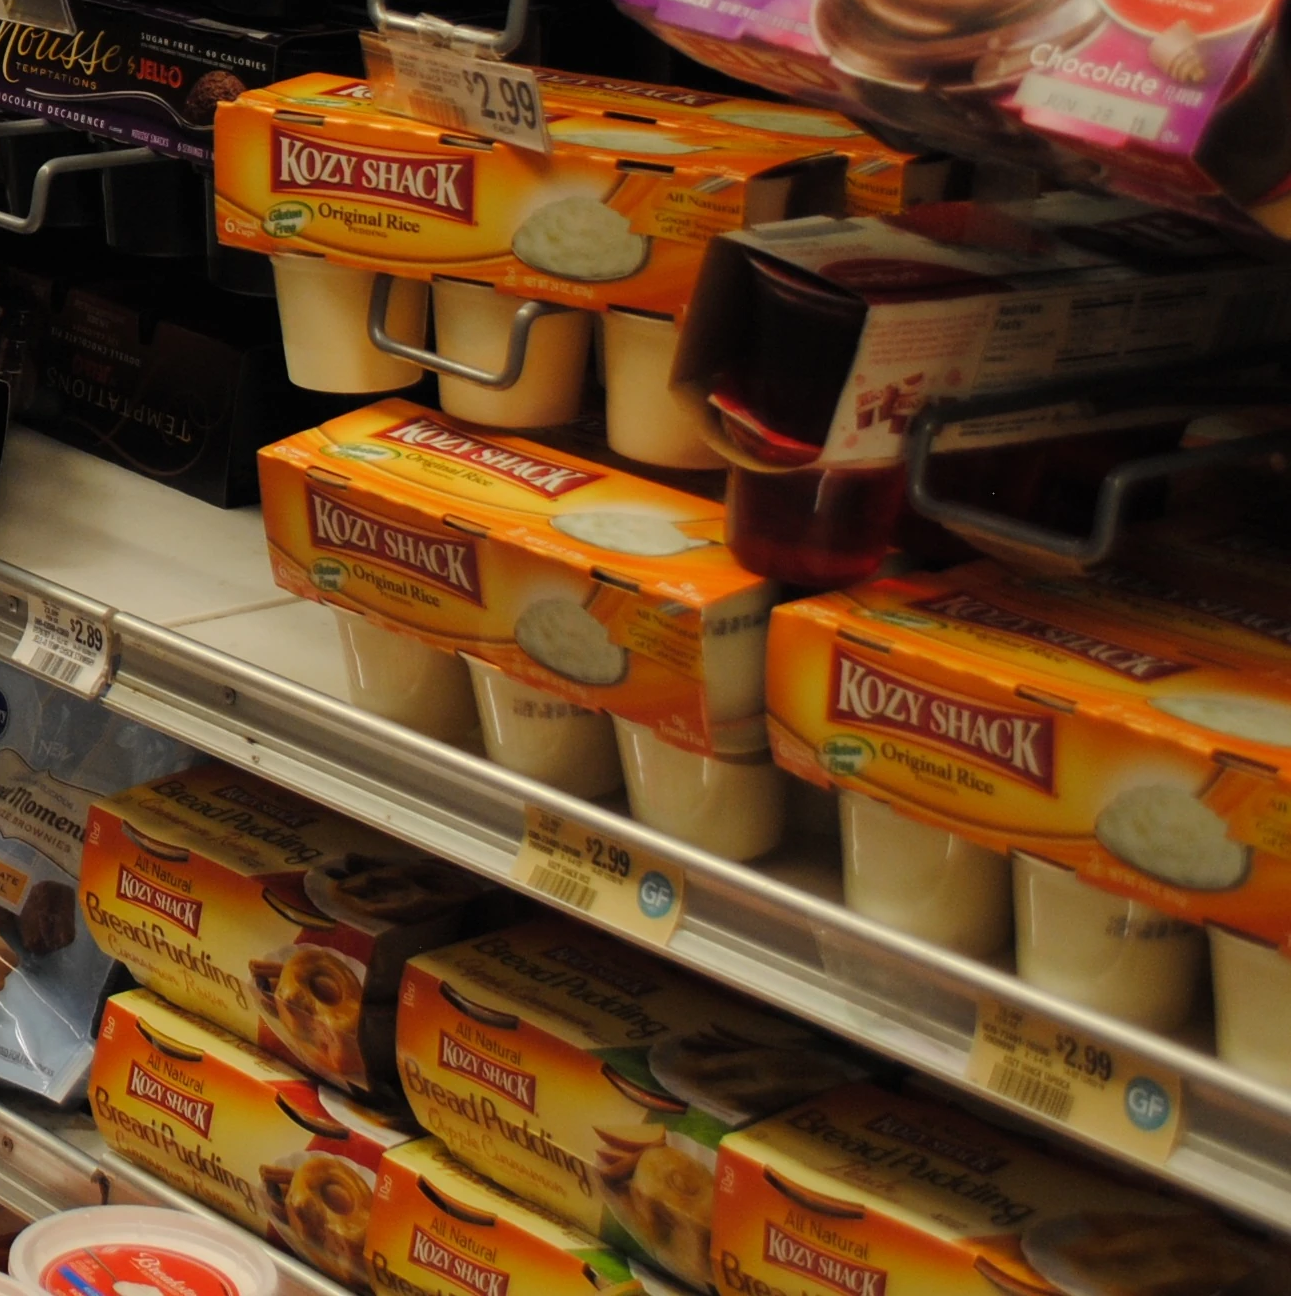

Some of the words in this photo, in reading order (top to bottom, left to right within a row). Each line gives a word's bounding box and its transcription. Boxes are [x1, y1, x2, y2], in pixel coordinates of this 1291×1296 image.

[1028, 42, 1158, 98] Chocolate
[464, 75, 537, 130] $2.99
[279, 139, 357, 186] KOZY
[361, 157, 462, 211] SHACK
[317, 203, 384, 229] Original
[386, 215, 420, 234] Rice
[387, 420, 481, 459] KOZY
[474, 445, 579, 495] SHACK
[312, 495, 379, 547] KOZY
[383, 527, 473, 593] SHACK
[351, 564, 410, 593] Original
[411, 583, 441, 606] Rice
[69, 620, 104, 652] $2.89
[837, 658, 926, 727] KOZY
[929, 700, 1043, 777] SHACK
[880, 741, 953, 782] Original
[956, 767, 995, 795] Rice
[134, 853, 151, 872] All
[151, 864, 193, 894] Natural
[585, 836, 631, 877] $2.99
[154, 892, 198, 930] SHACK
[641, 881, 670, 907] GF
[85, 892, 150, 948] Bread
[150, 926, 250, 1011] Pudding
[455, 1021, 472, 1040] All
[473, 1030, 521, 1066] Natural
[1055, 1032, 1113, 1082] $2.99
[146, 1051, 162, 1069] All
[163, 1062, 205, 1095] Natural
[441, 1037, 481, 1071] KOZY
[482, 1063, 531, 1105] SHACK
[94, 1087, 159, 1148] Bread
[164, 1090, 209, 1131] SHACK
[1128, 1087, 1166, 1117] GF
[404, 1057, 478, 1124] Bread
[481, 1097, 595, 1196] Pudding
[413, 1229, 452, 1266] KOZY
[767, 1232, 818, 1274] KOZY
[809, 1226, 870, 1261] Natural
